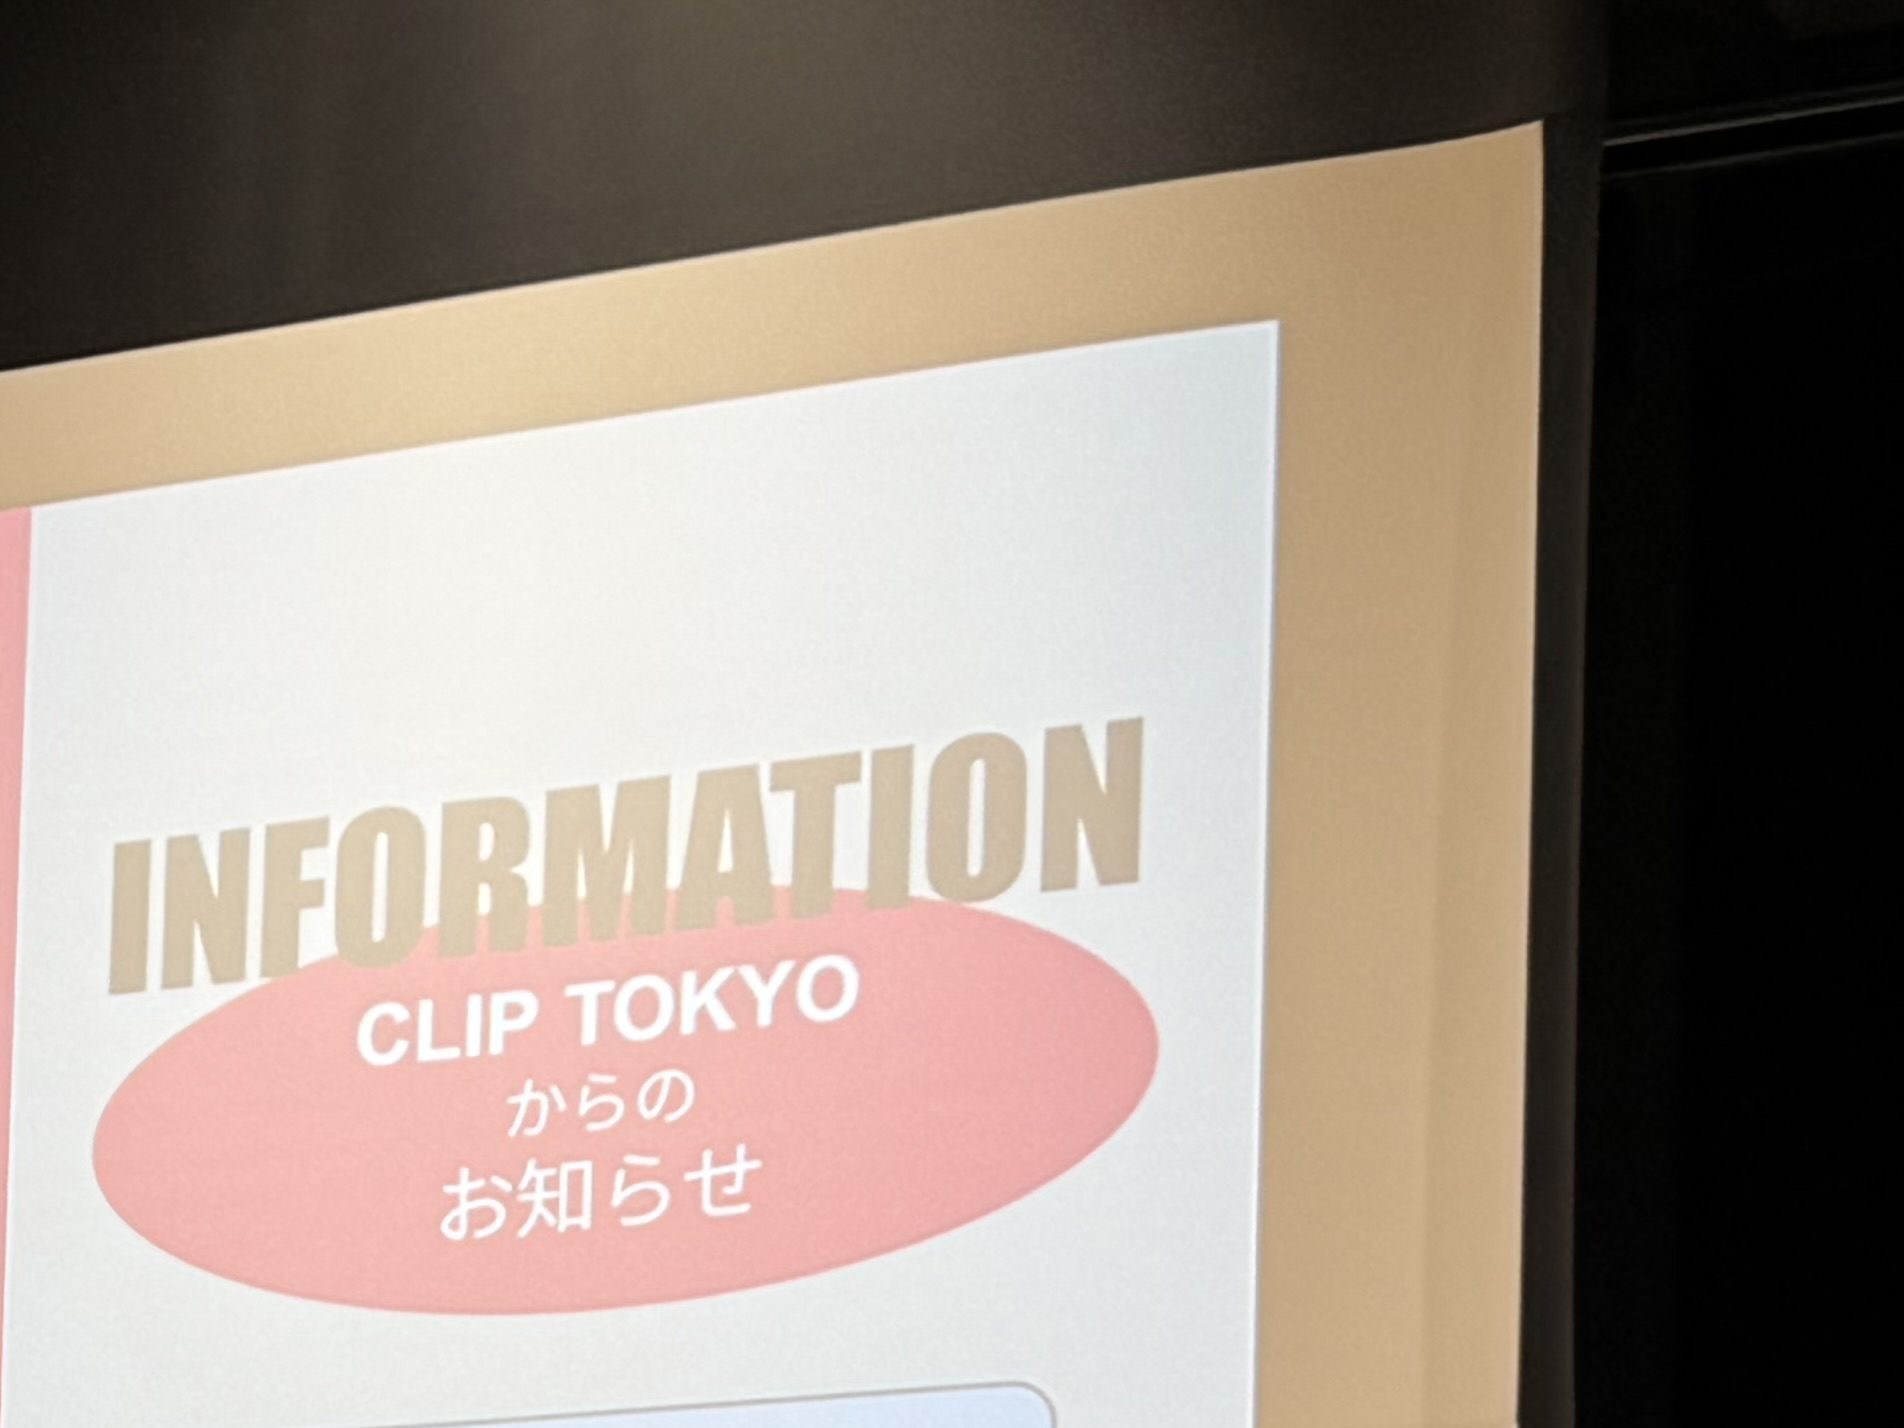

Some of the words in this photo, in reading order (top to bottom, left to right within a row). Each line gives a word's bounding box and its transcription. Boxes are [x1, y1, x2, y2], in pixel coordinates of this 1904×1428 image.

[108, 716, 1145, 996] INFORMATION
[355, 985, 539, 1066] CLIP
[563, 953, 860, 1046] TOKYO
[506, 1067, 696, 1141] からの
[437, 1143, 765, 1241] お知らせ
